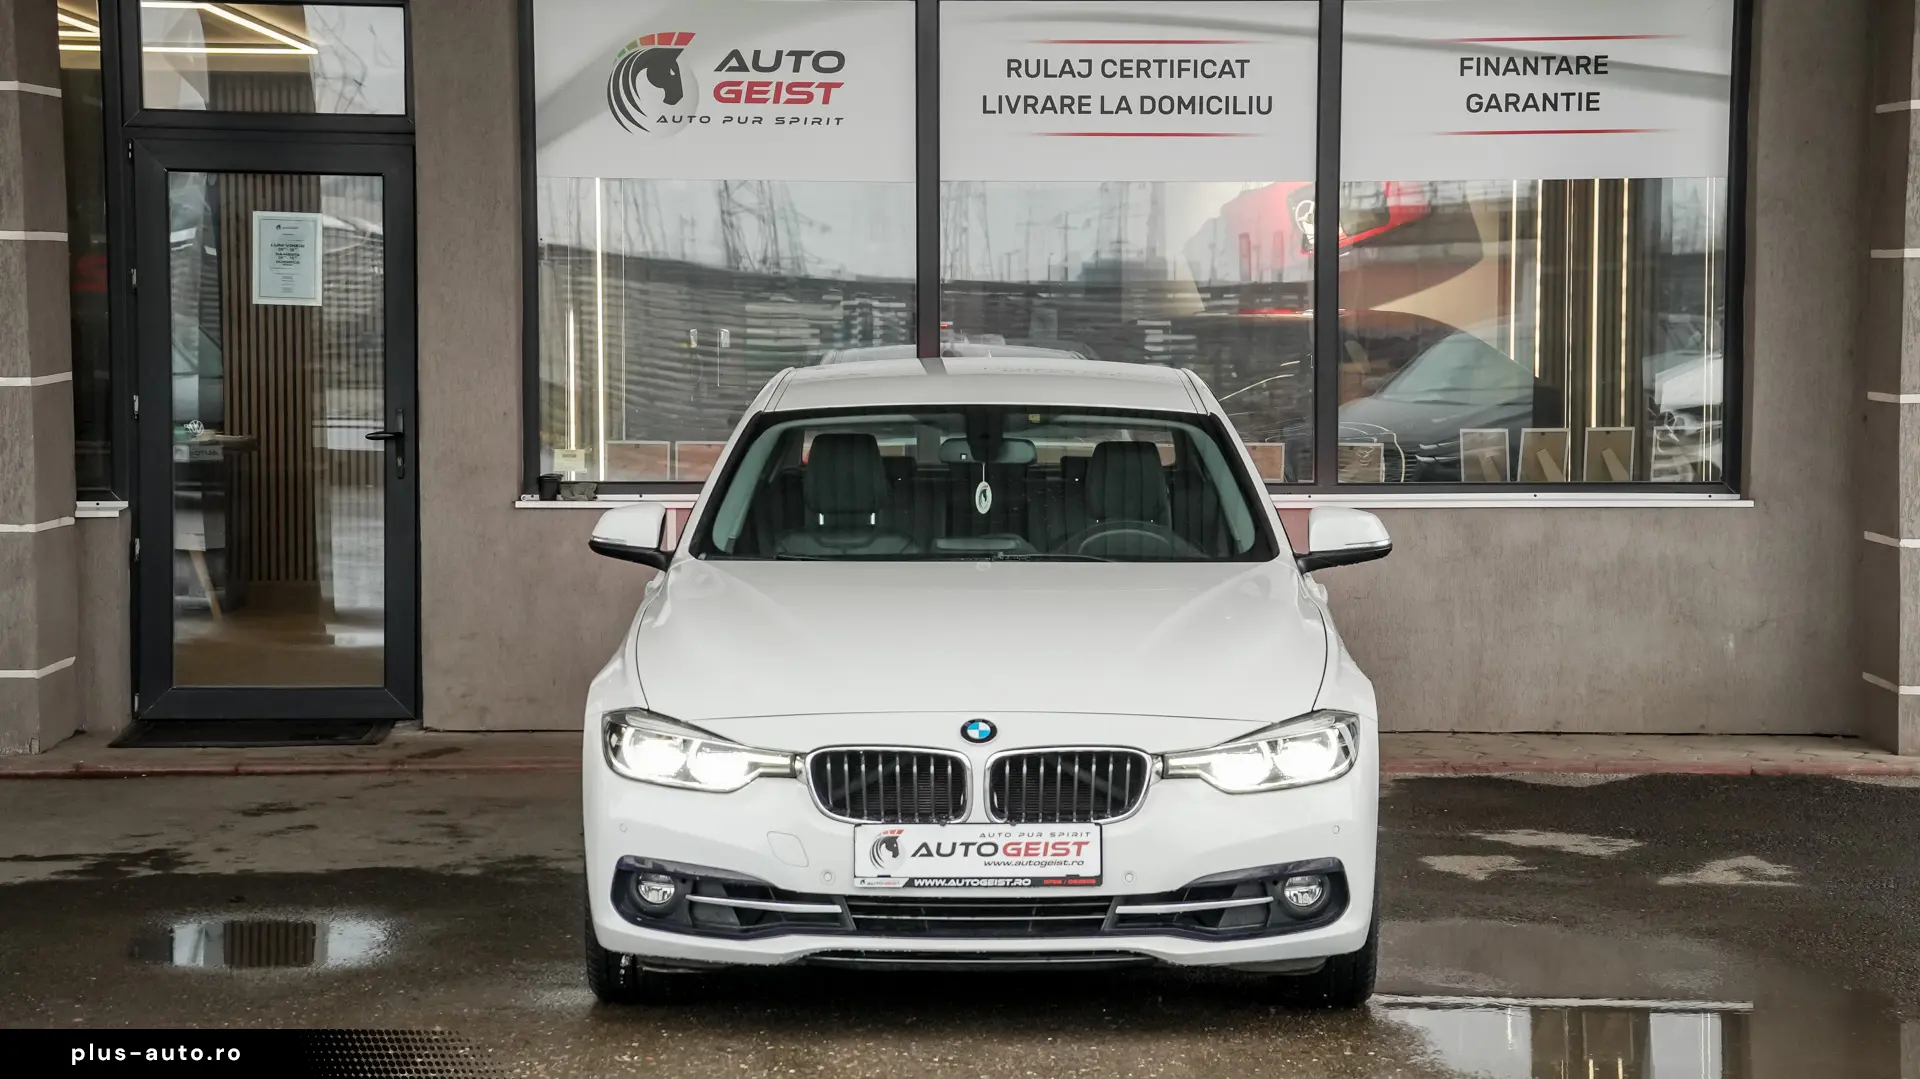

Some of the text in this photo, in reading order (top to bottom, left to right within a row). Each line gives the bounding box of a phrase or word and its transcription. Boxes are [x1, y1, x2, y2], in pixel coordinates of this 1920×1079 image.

[714, 49, 846, 73] AUTO
[1006, 58, 1250, 79] RULAJ CERTIFICAT
[1459, 54, 1609, 77] FINANTARE
[713, 80, 845, 105] GEIST
[1466, 91, 1601, 113] GARANTIE
[982, 94, 1273, 115] LIVRARE LA DOMICILIU
[656, 114, 844, 126] AUTO PUR SPIRIT
[983, 859, 1084, 868] www.autogeist.ro
[913, 878, 1032, 887] WWW.AUTOGEIST.RO
